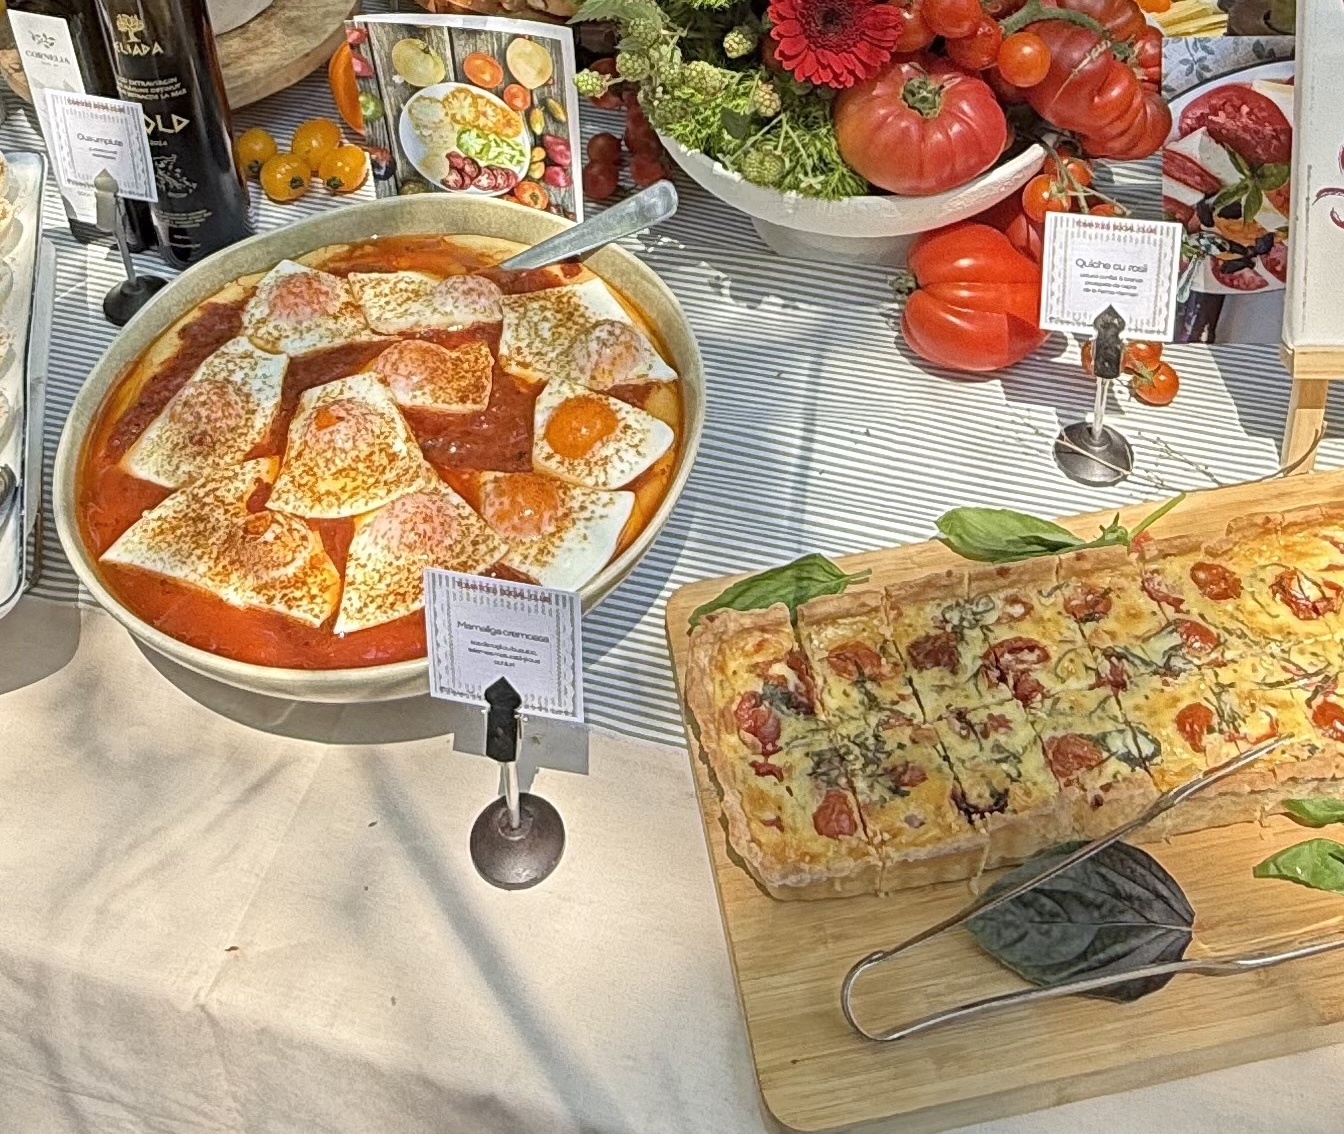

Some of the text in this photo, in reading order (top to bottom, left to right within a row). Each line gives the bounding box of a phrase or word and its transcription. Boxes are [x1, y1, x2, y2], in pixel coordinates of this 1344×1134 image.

[144, 113, 190, 135] OLD
[1075, 258, 1112, 270] Quiche
[1112, 263, 1126, 271] cu
